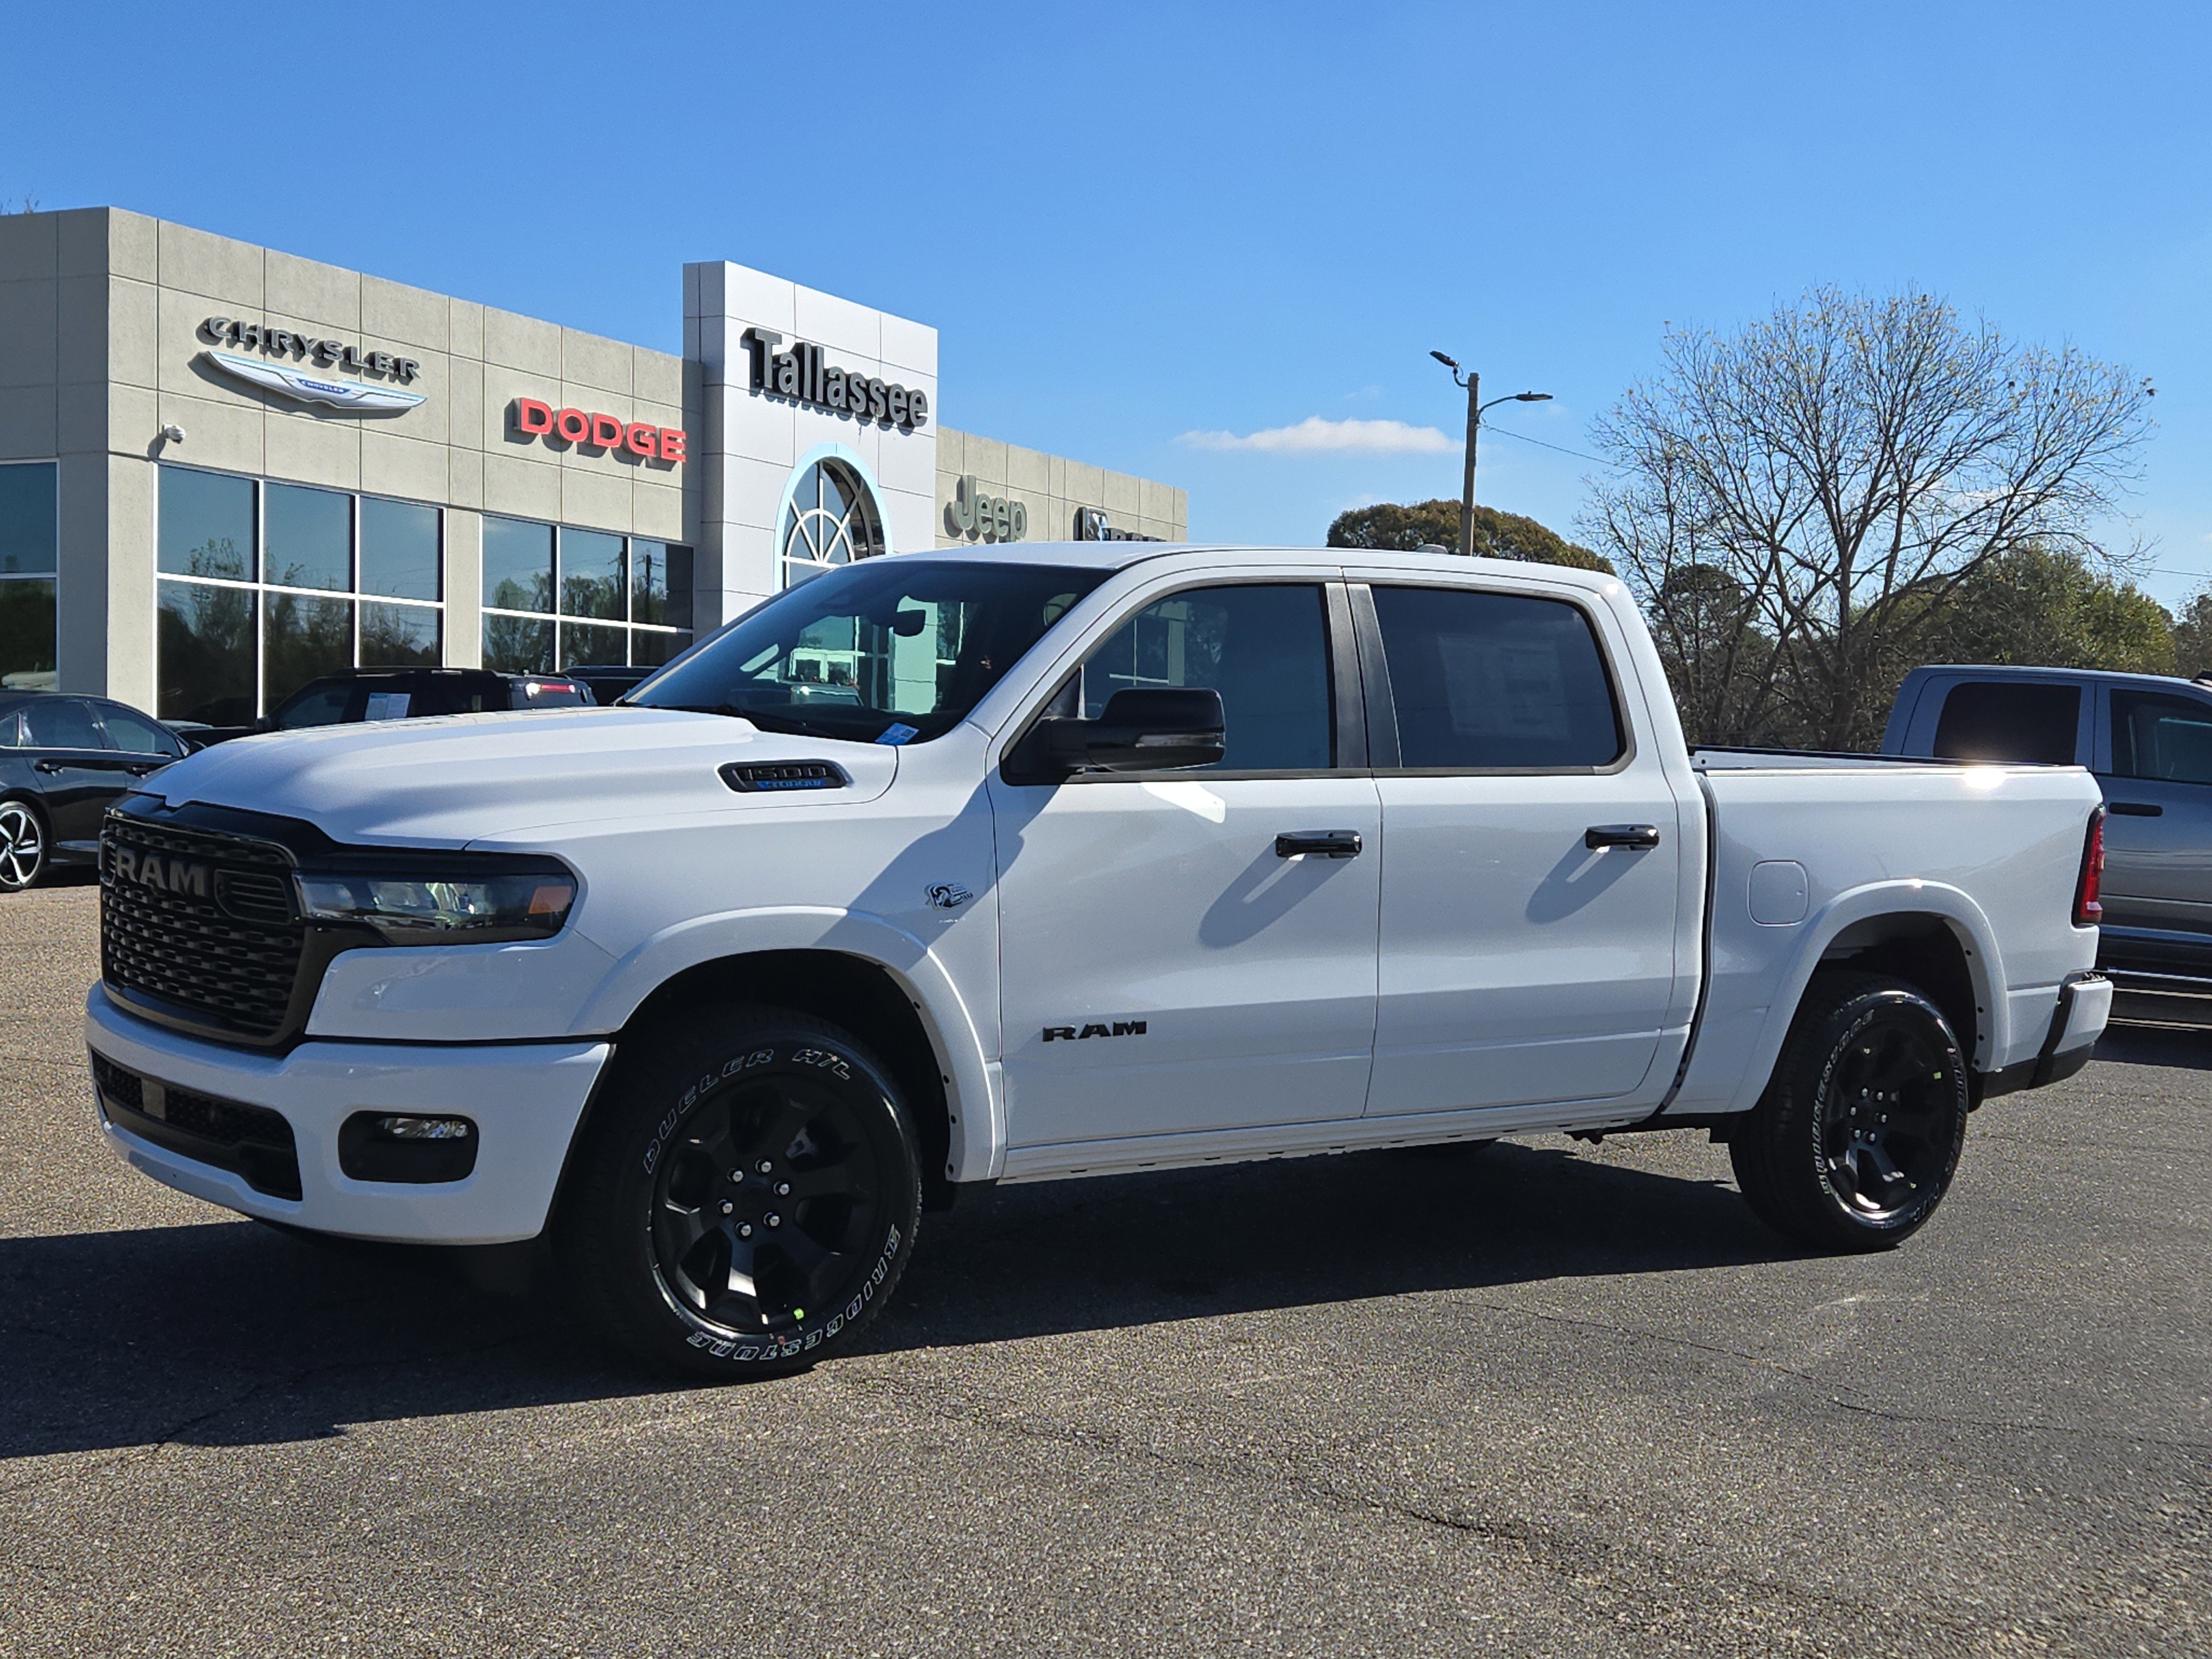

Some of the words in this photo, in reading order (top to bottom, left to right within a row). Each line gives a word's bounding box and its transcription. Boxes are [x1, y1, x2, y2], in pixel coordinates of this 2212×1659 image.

[209, 316, 422, 381] CHRYSLER
[754, 327, 928, 427] Tallassee
[520, 397, 687, 462] DODGE
[954, 475, 1027, 542] Jeep
[740, 766, 827, 780] 1500
[115, 847, 208, 897] RAM
[1043, 1020, 1147, 1041] RAM
[643, 1049, 774, 1175] DUELER
[791, 1048, 851, 1080] H/L
[686, 1223, 901, 1361] BRIDGESTONE
